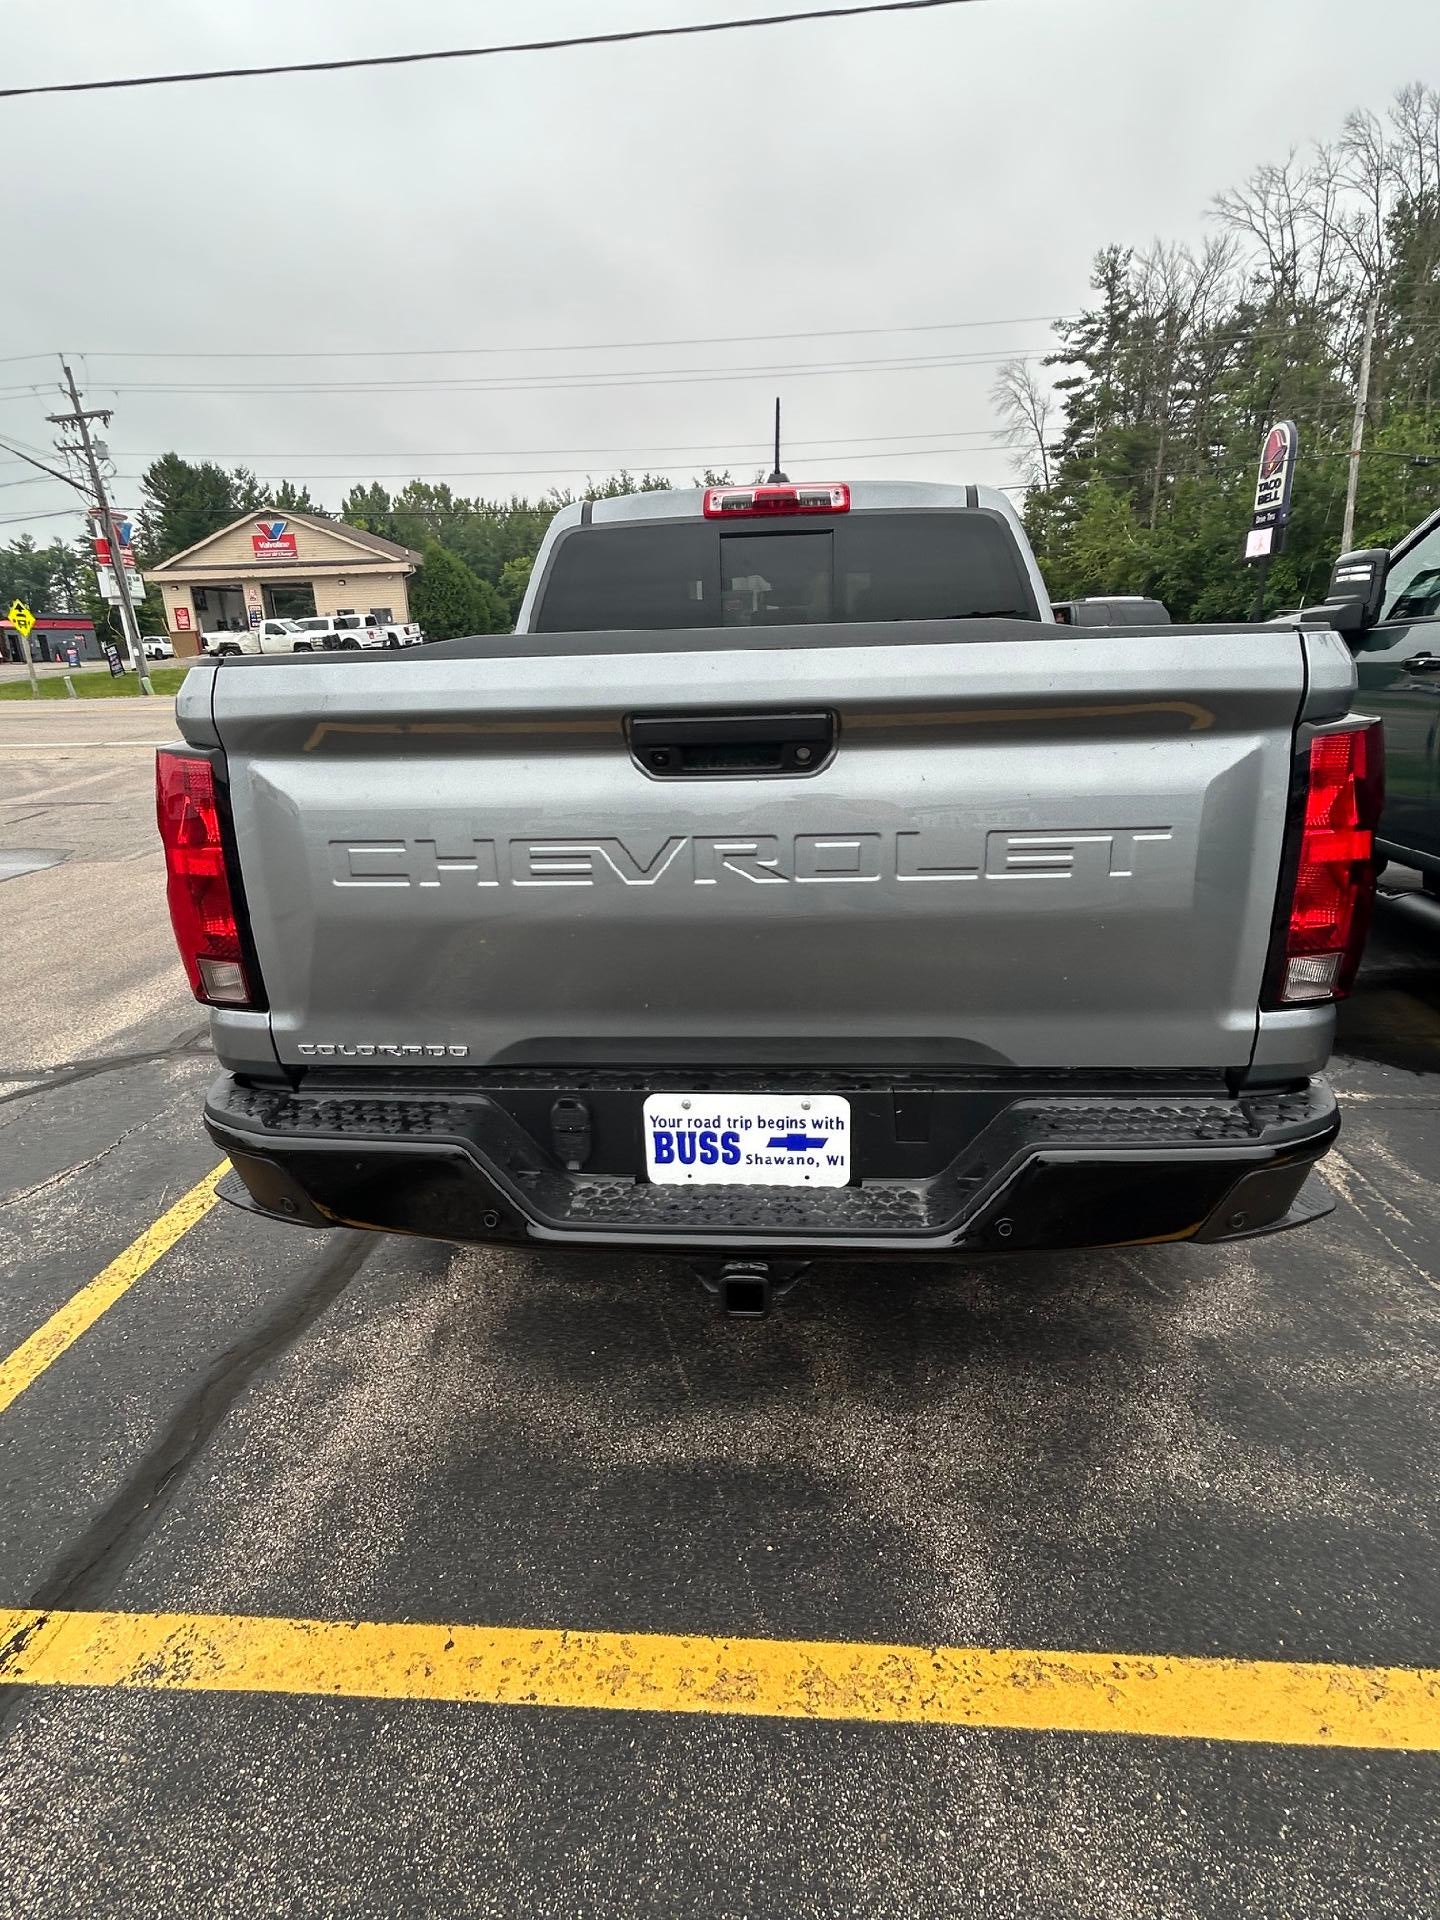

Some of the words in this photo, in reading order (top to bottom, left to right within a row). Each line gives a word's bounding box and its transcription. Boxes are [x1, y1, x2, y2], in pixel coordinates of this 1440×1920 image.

[1259, 478, 1281, 492] TACO
[1258, 490, 1280, 505] BELL
[258, 541, 290, 549] Valvoline
[328, 825, 1174, 888] CHEVROLET
[297, 1044, 470, 1057] COLORADO
[650, 1115, 682, 1129] Your
[687, 1115, 721, 1129] road
[727, 1115, 752, 1131] trip
[757, 1115, 806, 1131] begins
[811, 1116, 845, 1130] with
[653, 1131, 741, 1165] BUSS
[745, 1153, 820, 1167] Shawano,
[826, 1154, 845, 1166] WI
